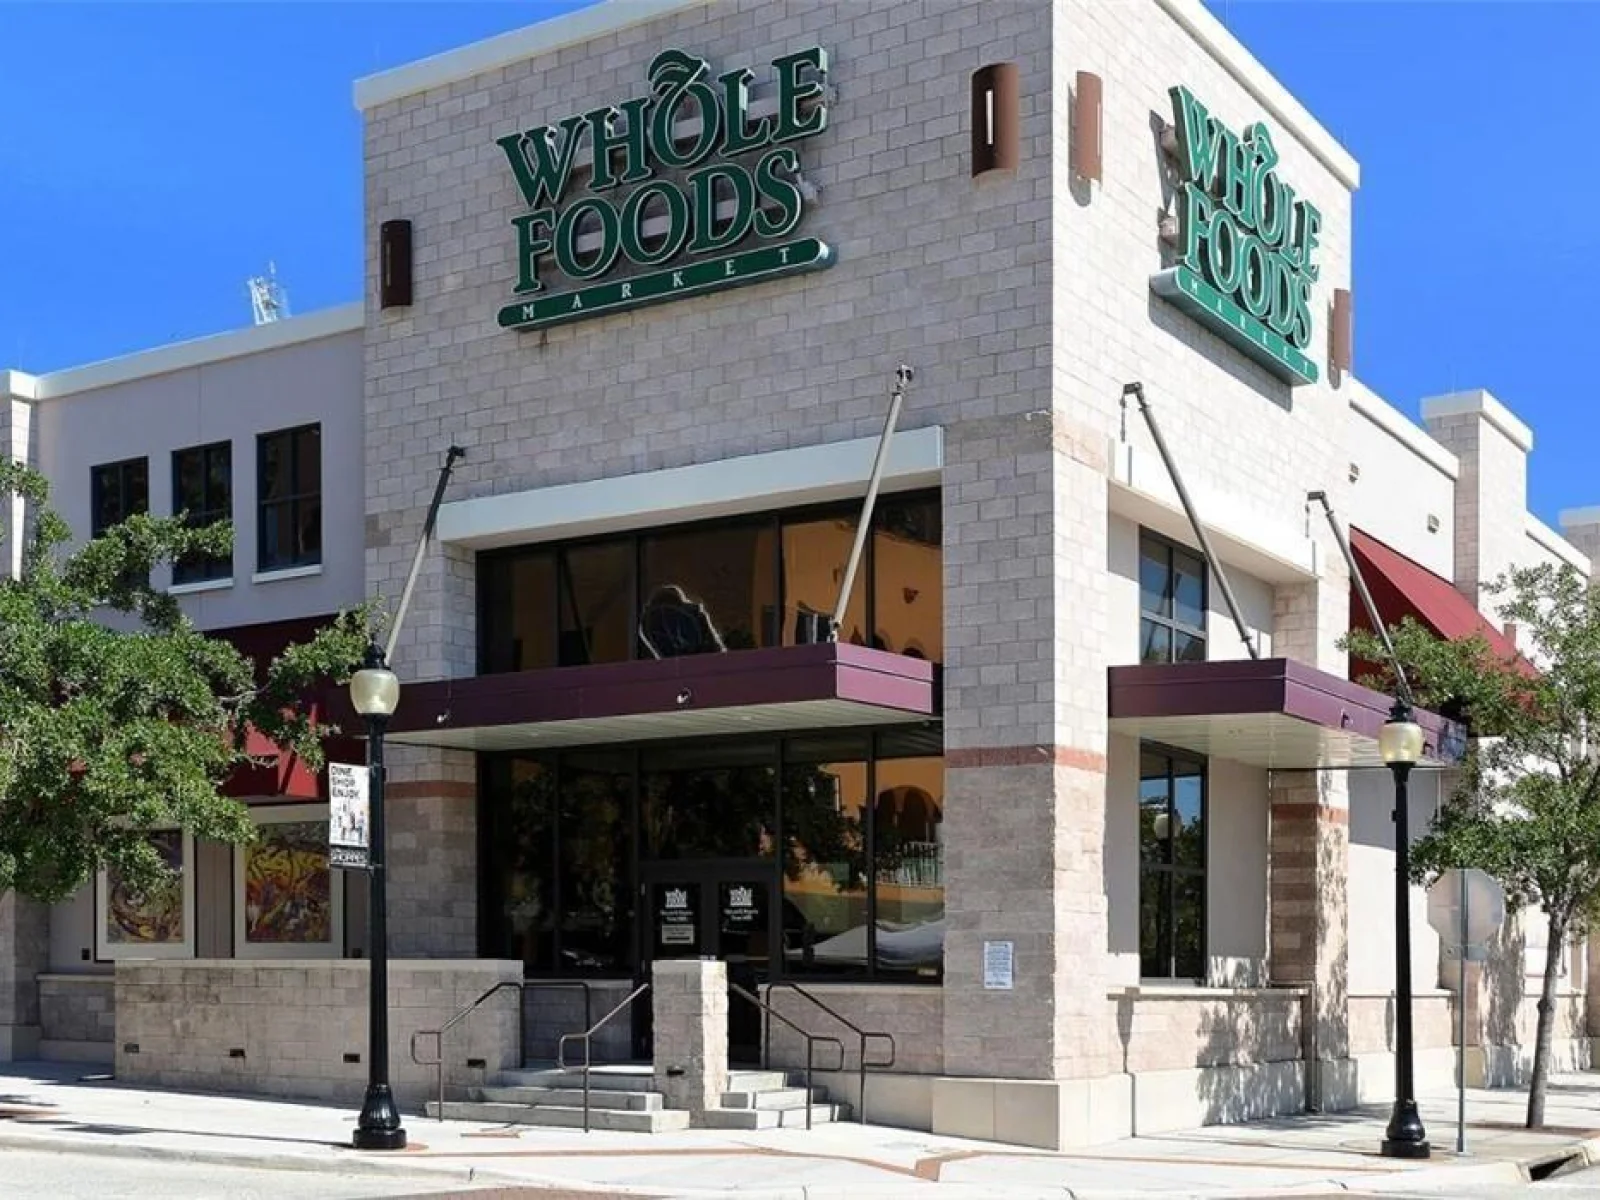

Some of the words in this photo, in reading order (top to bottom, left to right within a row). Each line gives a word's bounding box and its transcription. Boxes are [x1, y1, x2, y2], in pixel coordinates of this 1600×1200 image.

[496, 47, 827, 208] WHOLE
[1168, 85, 1322, 282] WHOLE
[511, 149, 802, 294] FOODS
[522, 247, 791, 320] MARKET
[1180, 181, 1313, 349] FOODS
